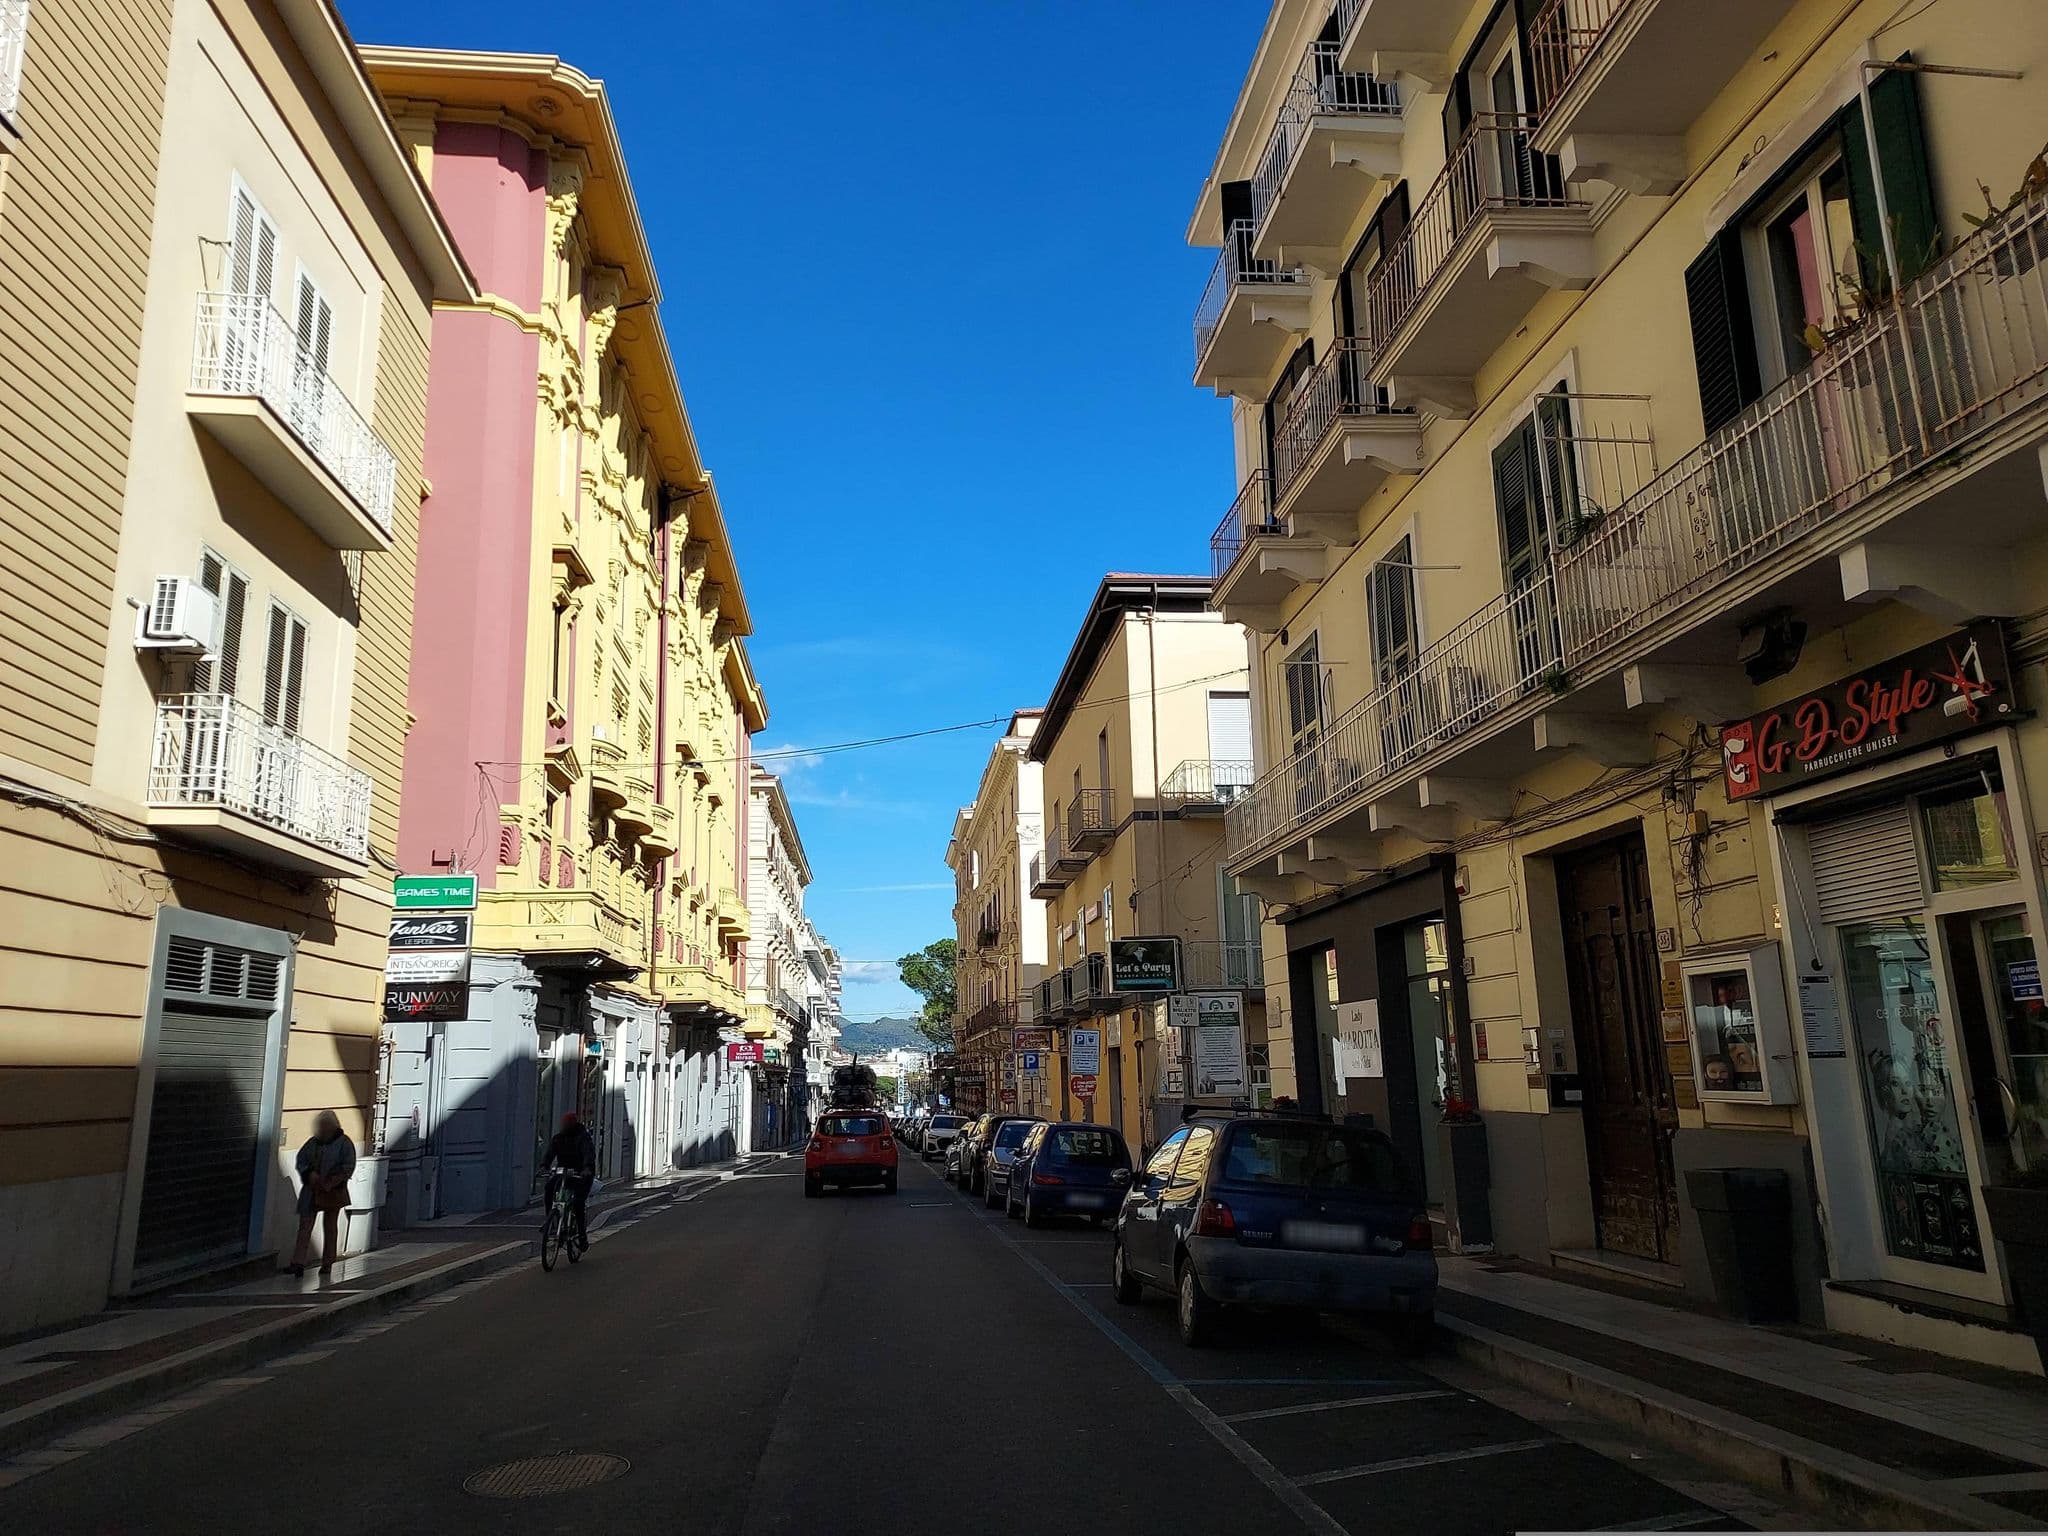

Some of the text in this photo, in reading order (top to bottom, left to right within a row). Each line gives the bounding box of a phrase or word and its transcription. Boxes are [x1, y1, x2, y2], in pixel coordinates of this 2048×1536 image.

[1804, 734, 1899, 773] PARRUCCHIERE UNISEX
[396, 887, 471, 897] GAMES TIME
[1115, 962, 1171, 974] Let's Party
[387, 991, 460, 1004] RUNWAY
[1351, 1008, 1363, 1025] Lady
[1076, 1035, 1084, 1044] P
[1340, 1028, 1380, 1050] MAROTTA
[1026, 1055, 1036, 1068] P
